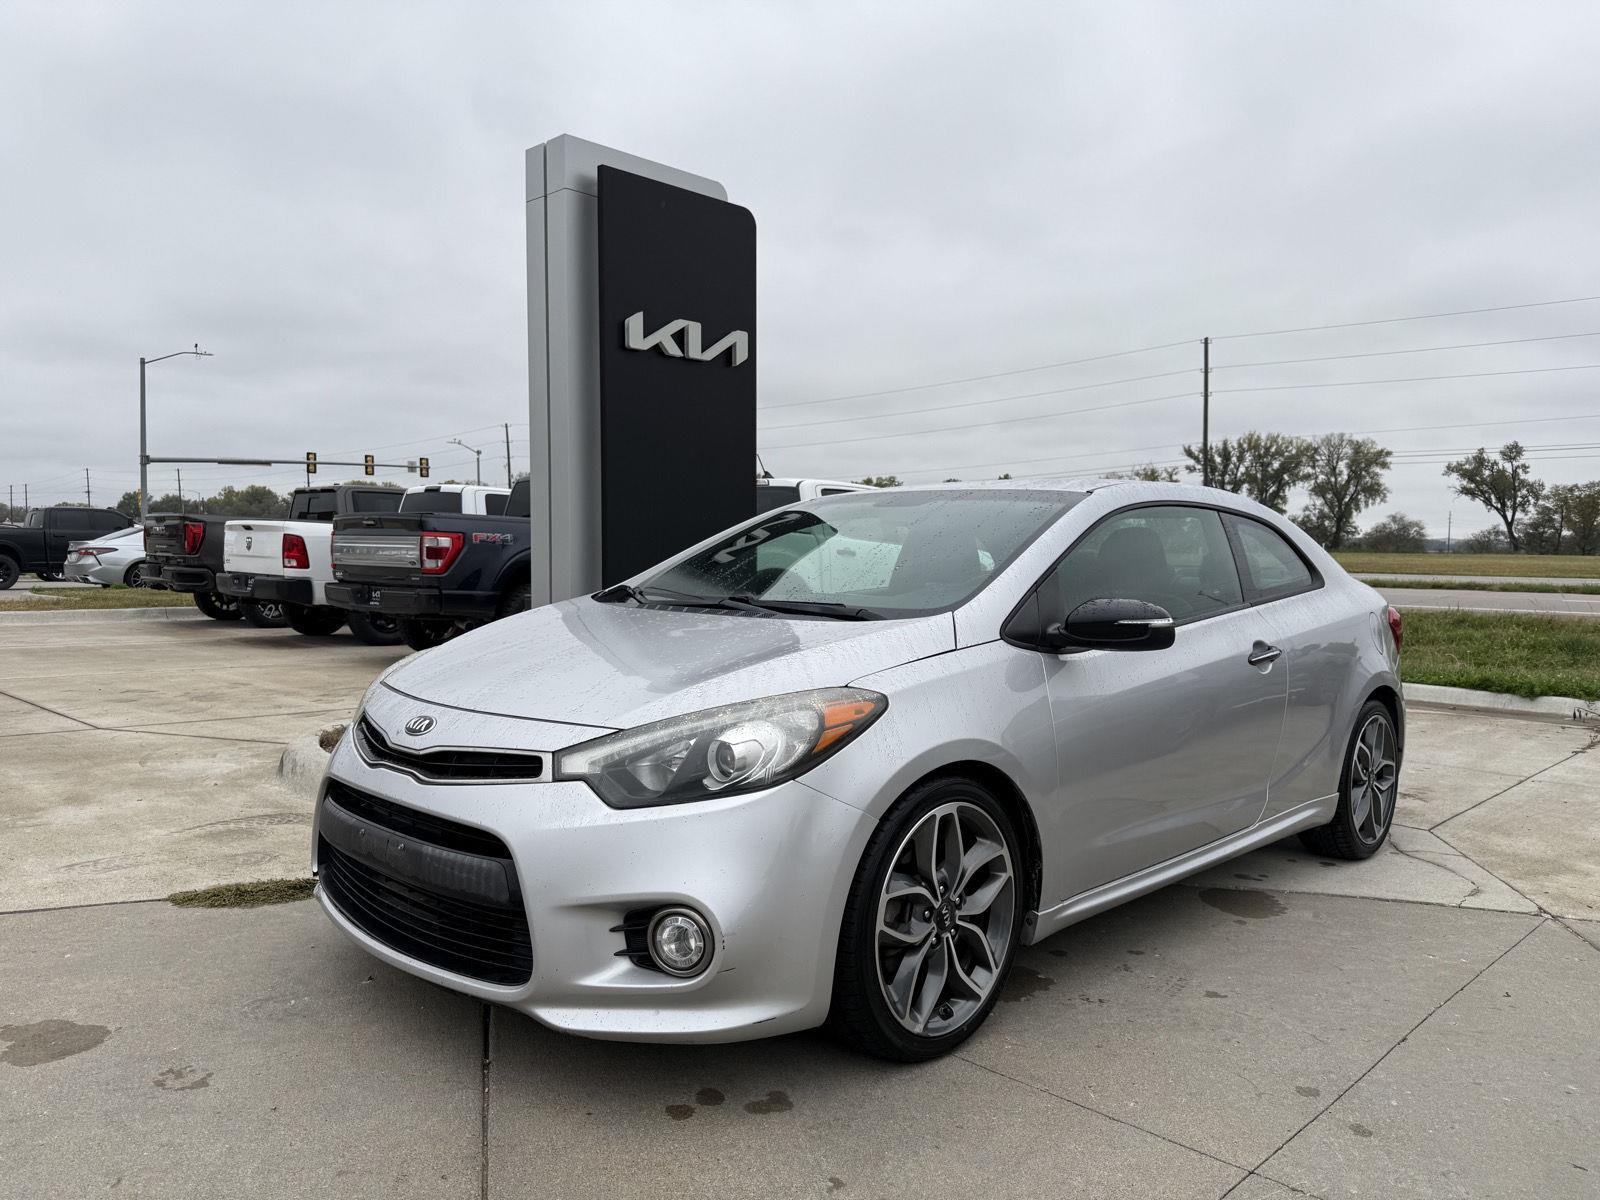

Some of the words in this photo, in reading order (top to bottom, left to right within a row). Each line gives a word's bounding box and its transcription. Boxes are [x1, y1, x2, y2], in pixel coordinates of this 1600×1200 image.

[625, 311, 748, 366] KIA
[472, 532, 513, 544] FX4
[406, 717, 430, 732] KIA
